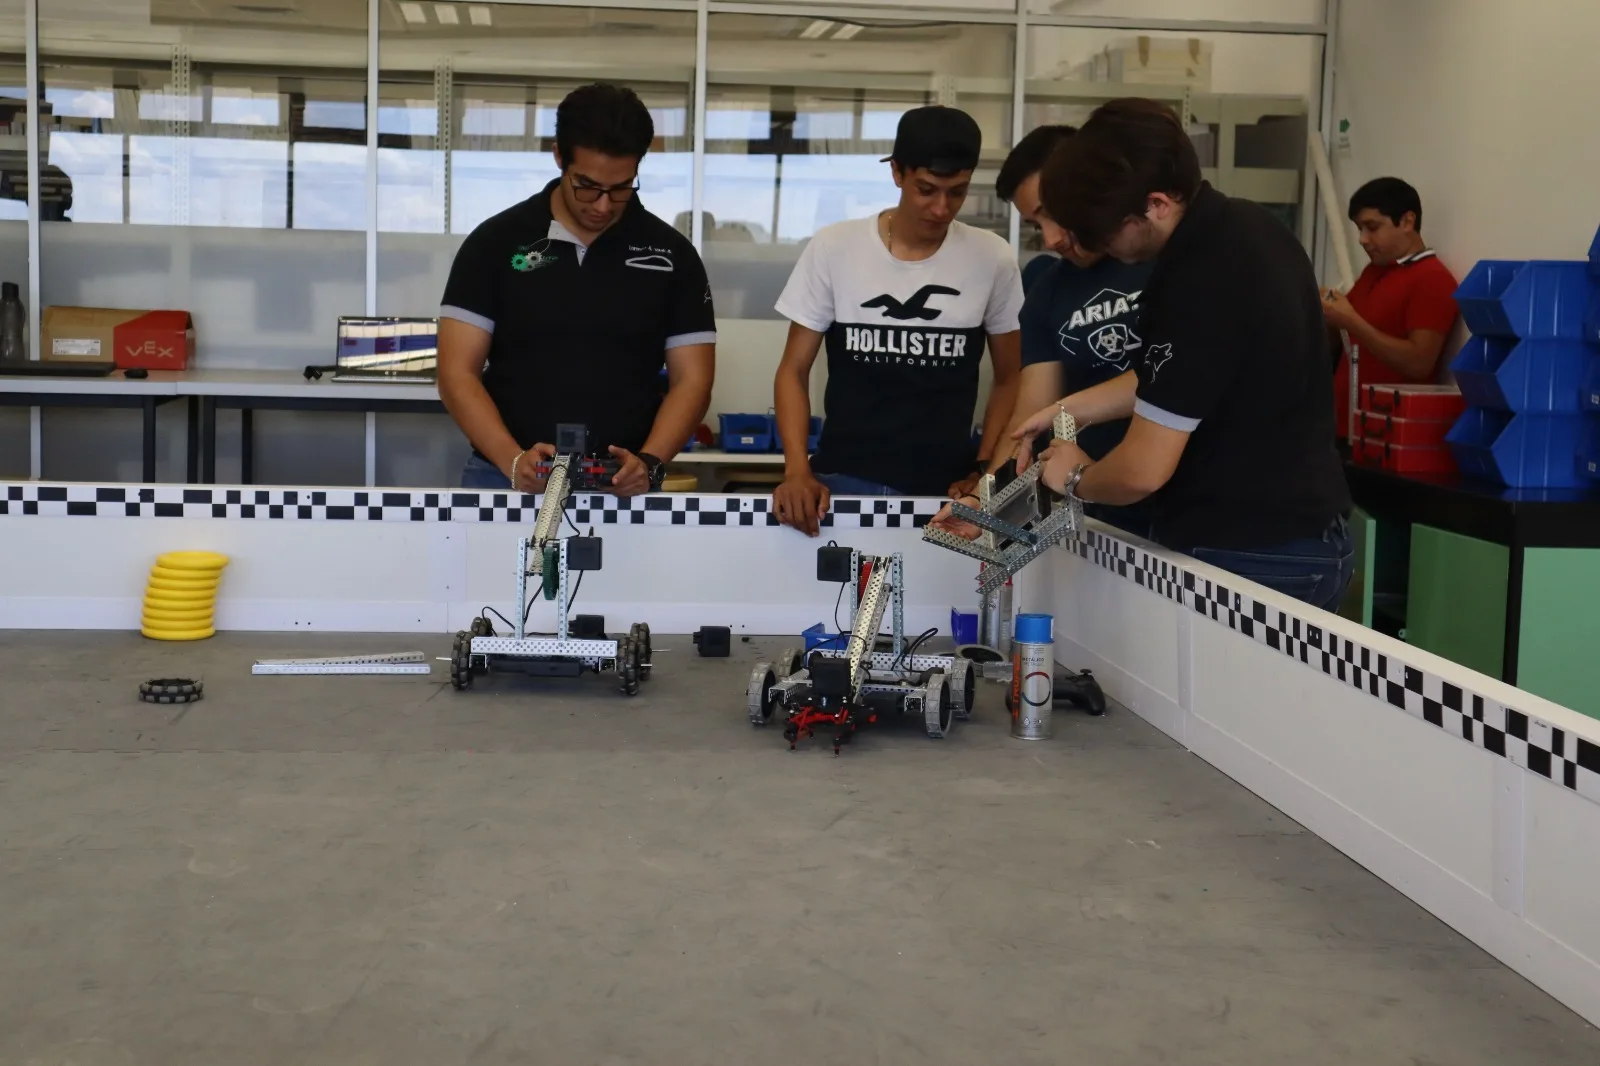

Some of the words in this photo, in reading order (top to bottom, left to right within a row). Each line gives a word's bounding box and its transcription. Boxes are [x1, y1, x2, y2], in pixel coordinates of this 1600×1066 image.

[126, 341, 173, 357] VEX
[846, 327, 967, 357] HOLLISTER
[854, 355, 956, 367] CALIFORNIA
